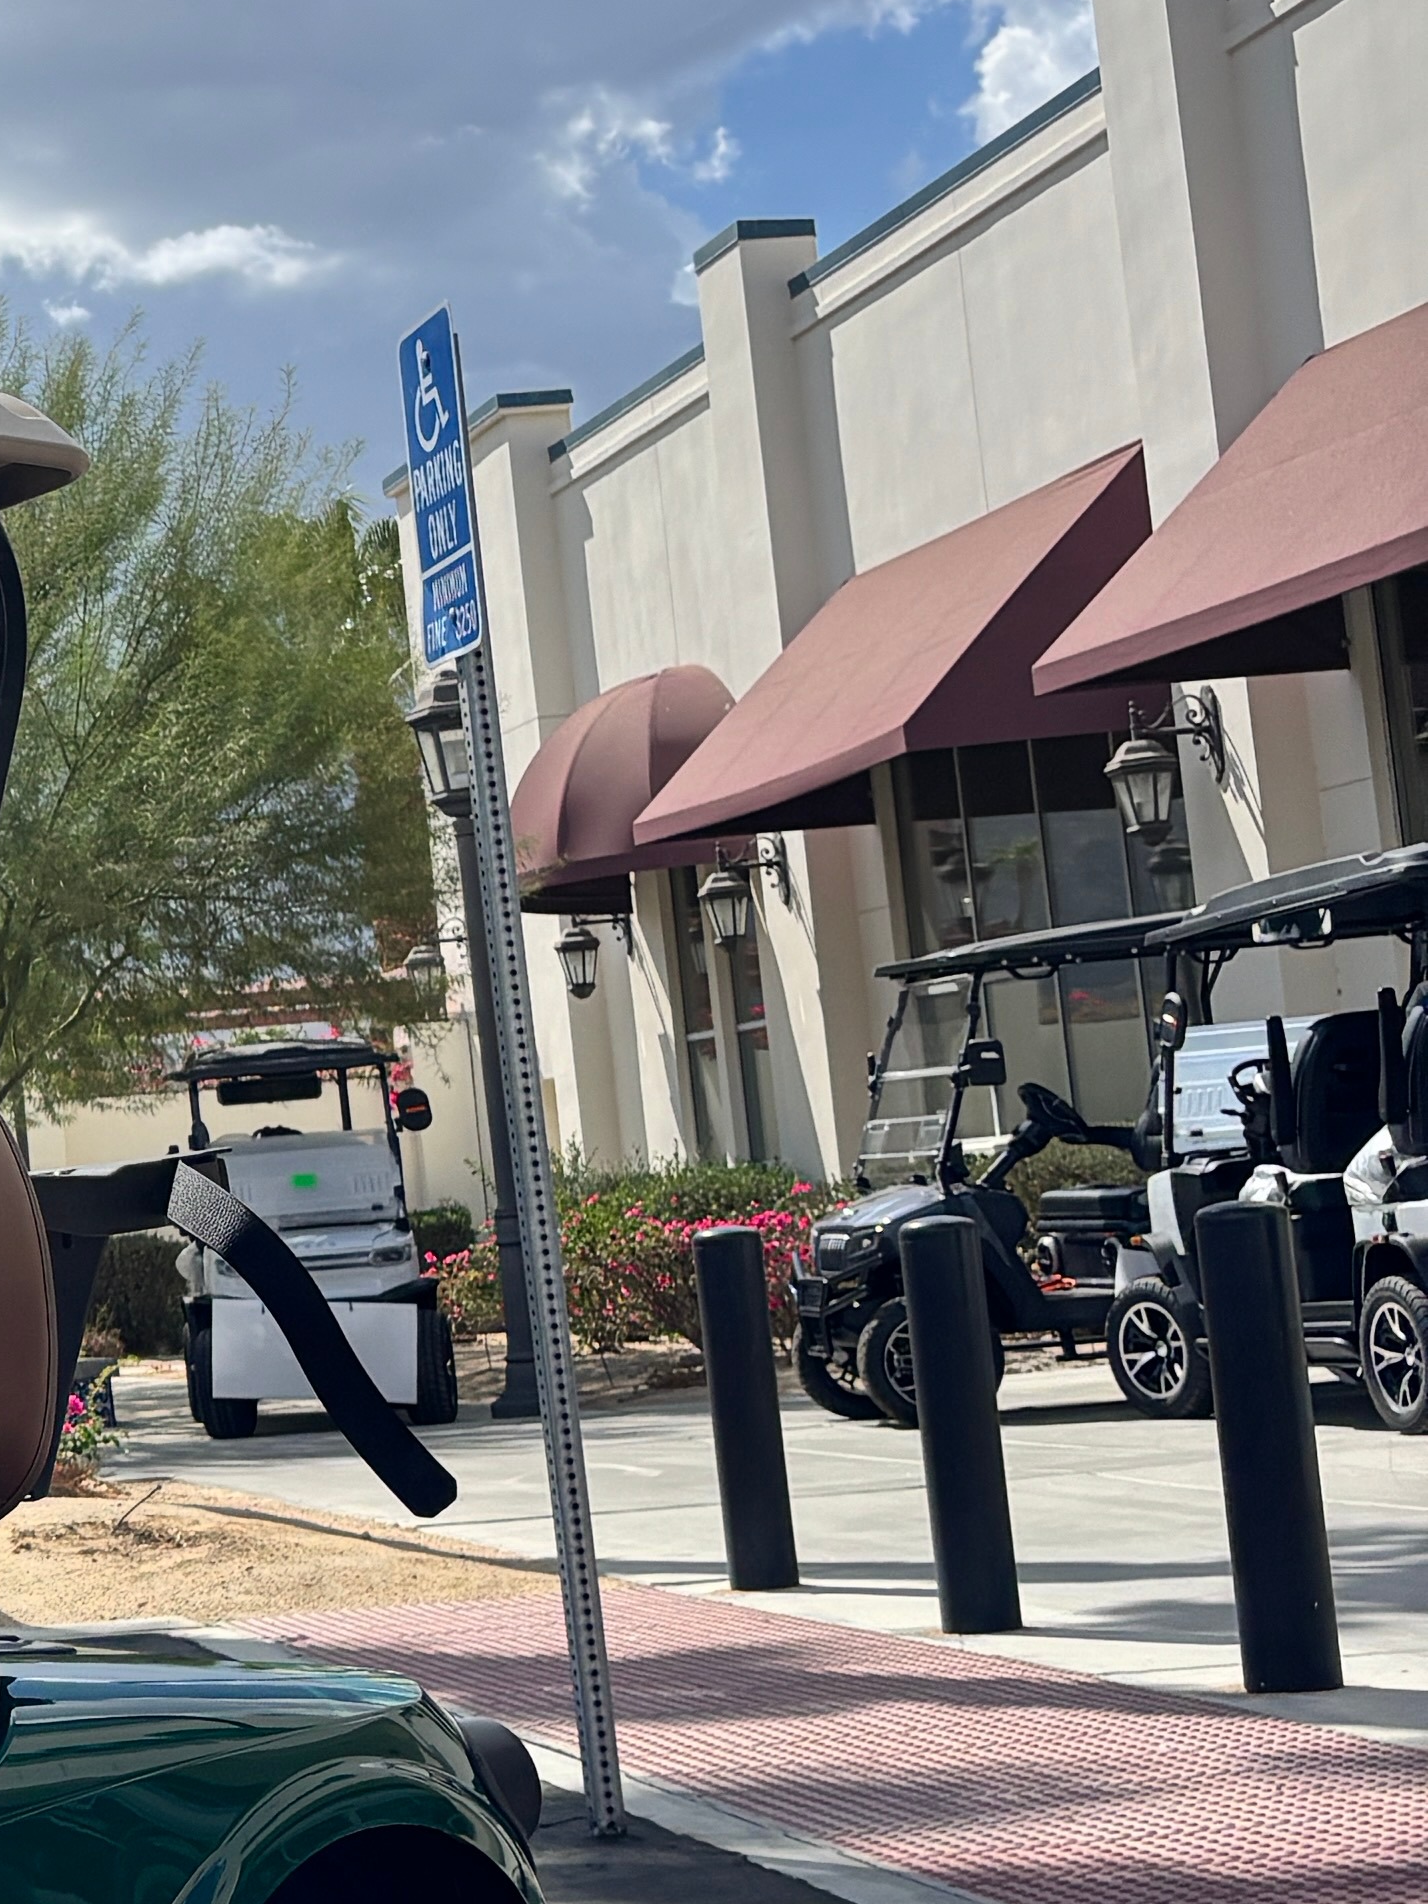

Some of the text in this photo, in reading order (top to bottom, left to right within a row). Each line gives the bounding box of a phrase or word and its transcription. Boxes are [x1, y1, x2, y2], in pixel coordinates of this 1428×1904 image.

[413, 439, 463, 513] PARKING
[428, 499, 456, 561] ONLY
[432, 562, 468, 613] MINIMUM
[427, 616, 447, 655] FINE
